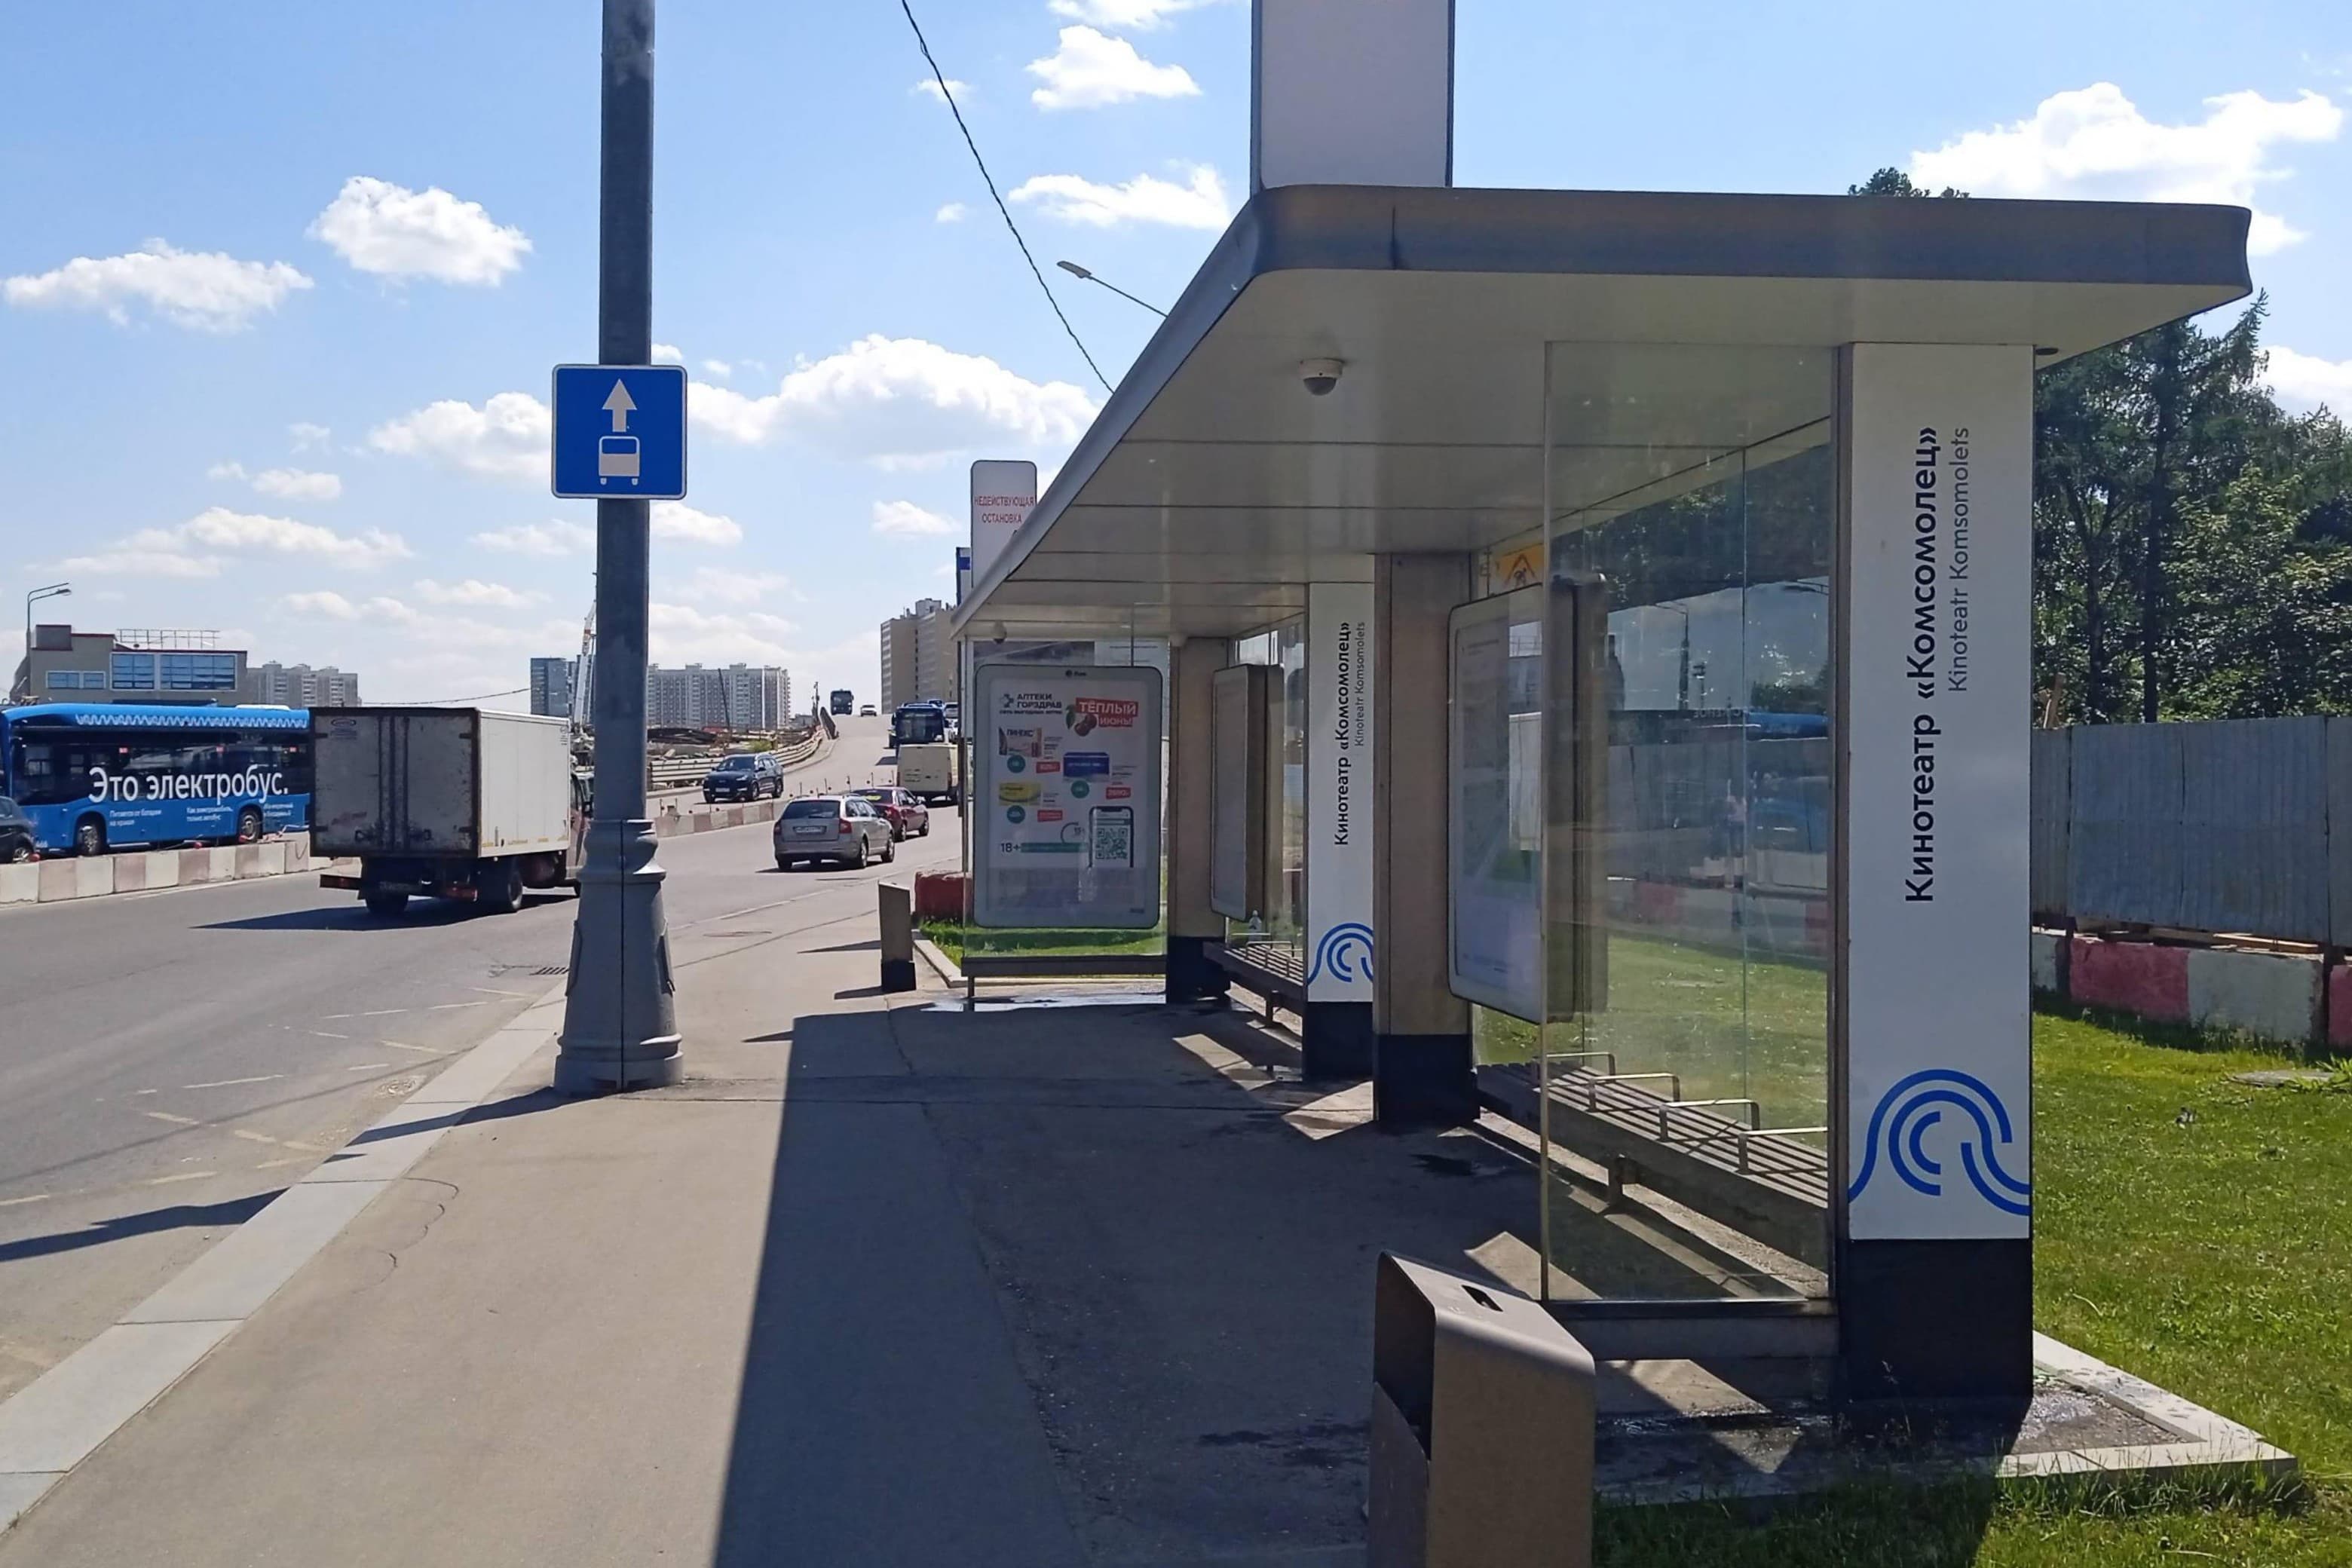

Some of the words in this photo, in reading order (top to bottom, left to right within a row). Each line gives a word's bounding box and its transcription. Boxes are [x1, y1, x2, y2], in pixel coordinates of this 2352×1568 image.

[975, 496, 1034, 507] НЕДЕЙСТВУЮЩАЯ
[982, 513, 1022, 523] ОСТАНОВКА
[1949, 427, 1969, 580] Komsomolets
[1906, 426, 1940, 700] «Комсомолец»
[1355, 621, 1364, 694] Komsomolets
[1948, 588, 1968, 691] Kinoteatr
[1080, 700, 1137, 715] ТЁПЛЫЙ
[1335, 622, 1351, 750] «Комсомолец»
[1355, 697, 1364, 746] Kinoteatr
[89, 767, 139, 803] Это
[146, 764, 289, 804] электробус.
[1334, 757, 1351, 845] Кинотеатр
[1905, 712, 1941, 902] Кинотеатр
[1000, 843, 1021, 853] 18+
